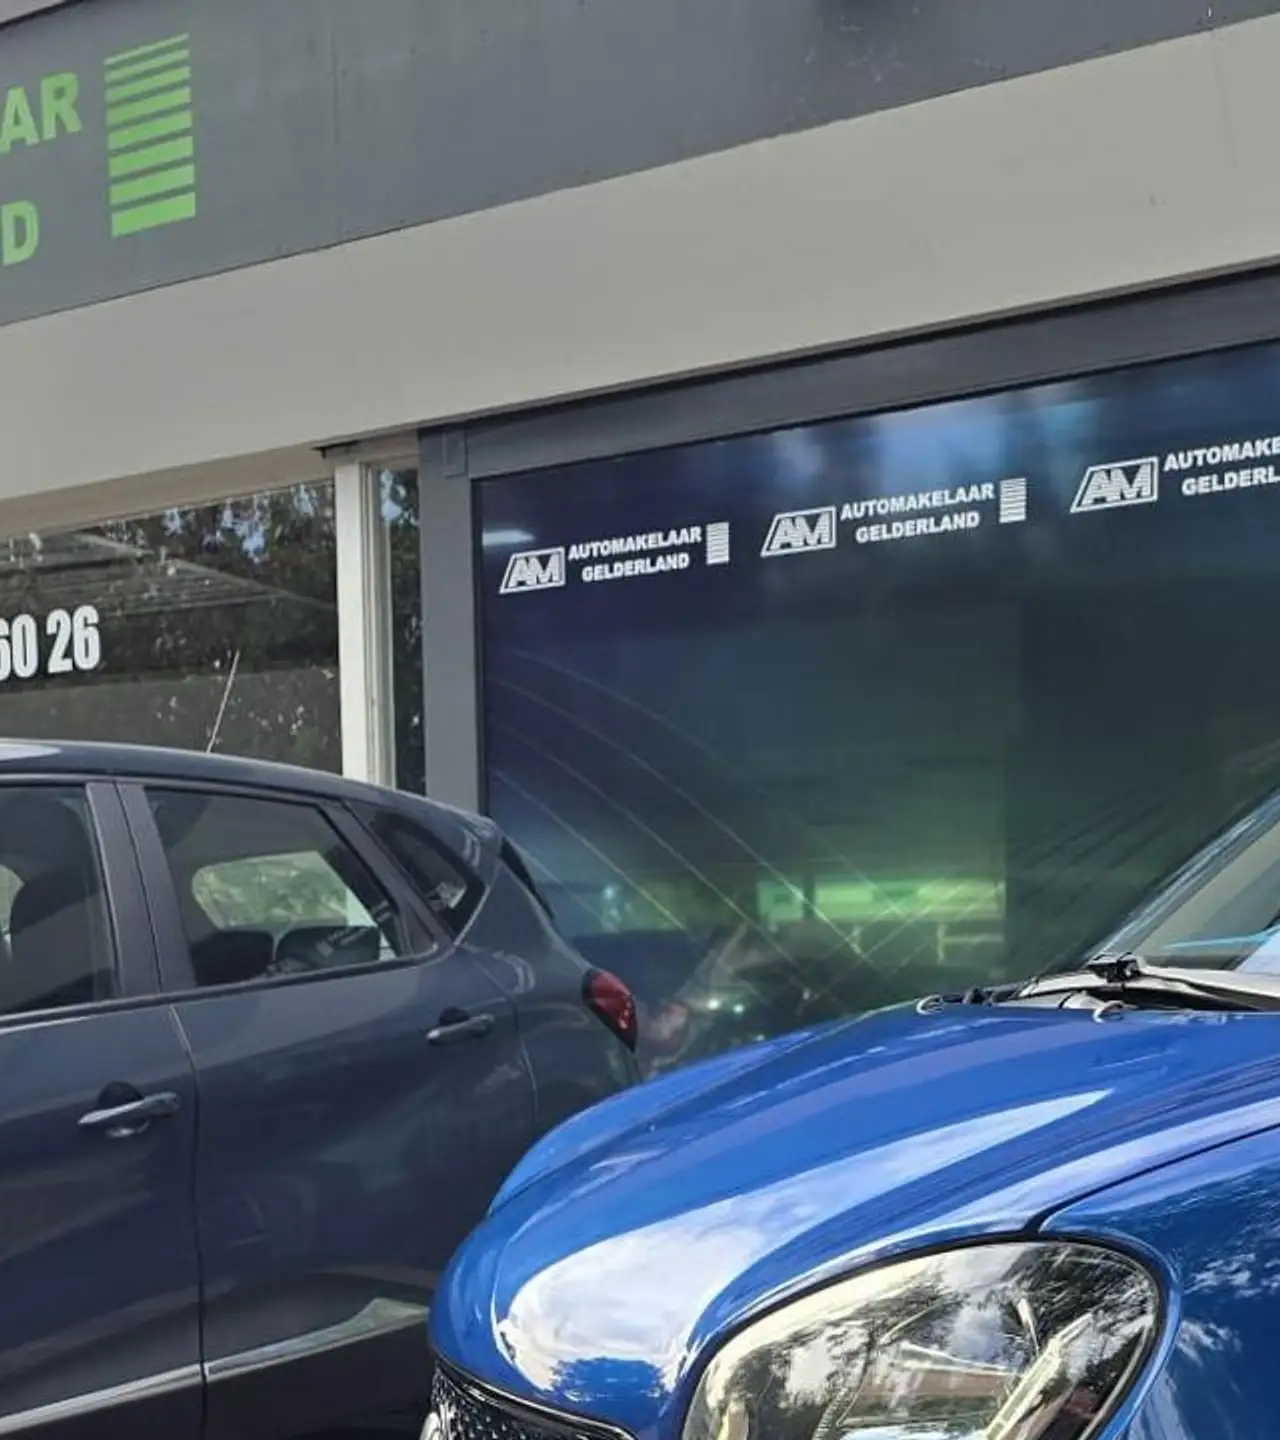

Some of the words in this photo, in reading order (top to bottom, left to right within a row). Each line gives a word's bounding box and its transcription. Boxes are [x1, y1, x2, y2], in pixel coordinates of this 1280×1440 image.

[840, 482, 995, 520] AUTOMAKELAAR
[1078, 461, 1155, 507] AM
[568, 526, 702, 561] AUTOMAKELAAR
[766, 511, 834, 552] AM
[855, 510, 981, 544] GELDERLAND
[507, 552, 561, 589] AM
[581, 552, 690, 583] GELDERLAND
[46, 604, 102, 674] 26
